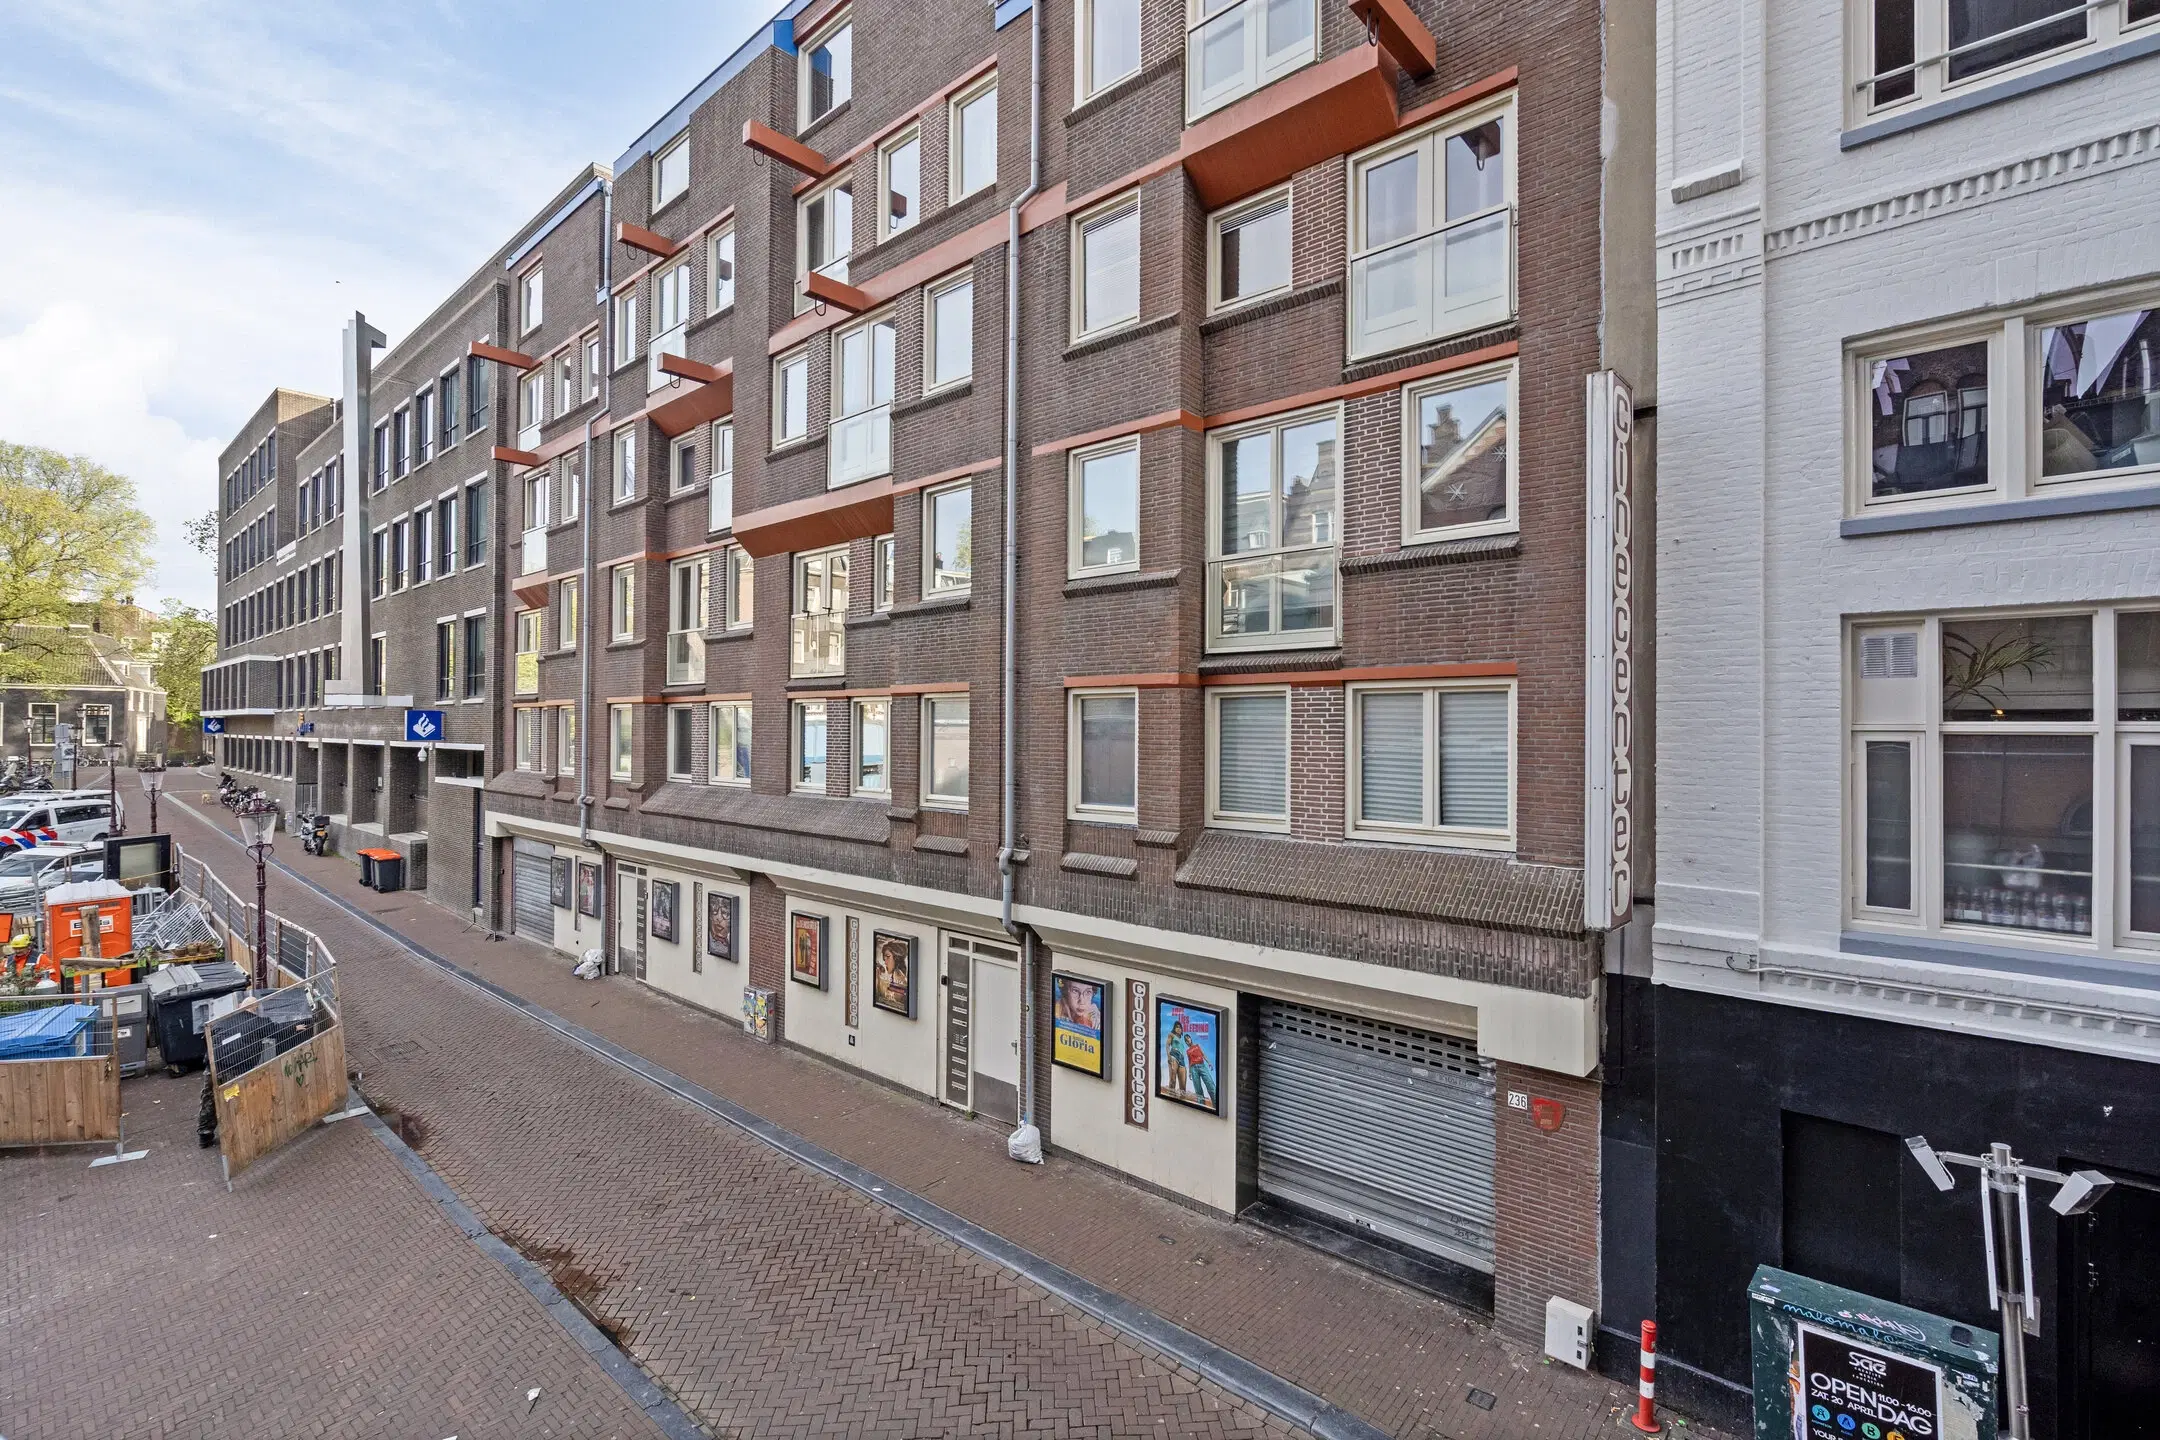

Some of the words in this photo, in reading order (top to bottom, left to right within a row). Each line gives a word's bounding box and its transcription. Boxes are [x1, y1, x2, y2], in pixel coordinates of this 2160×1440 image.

[1613, 385, 1631, 916] cinecenter
[850, 919, 858, 1026] cinecenter
[1059, 1033, 1095, 1054] Gloria
[1133, 982, 1146, 1123] cinecenter
[1509, 1093, 1526, 1108] 236
[1810, 1372, 1877, 1408] OPEN
[1811, 1388, 1829, 1401] ZAT.
[1831, 1395, 1844, 1406] 20
[1847, 1402, 1878, 1418] APRIL
[1878, 1393, 1900, 1407] 11.00
[1877, 1402, 1933, 1435] DAG
